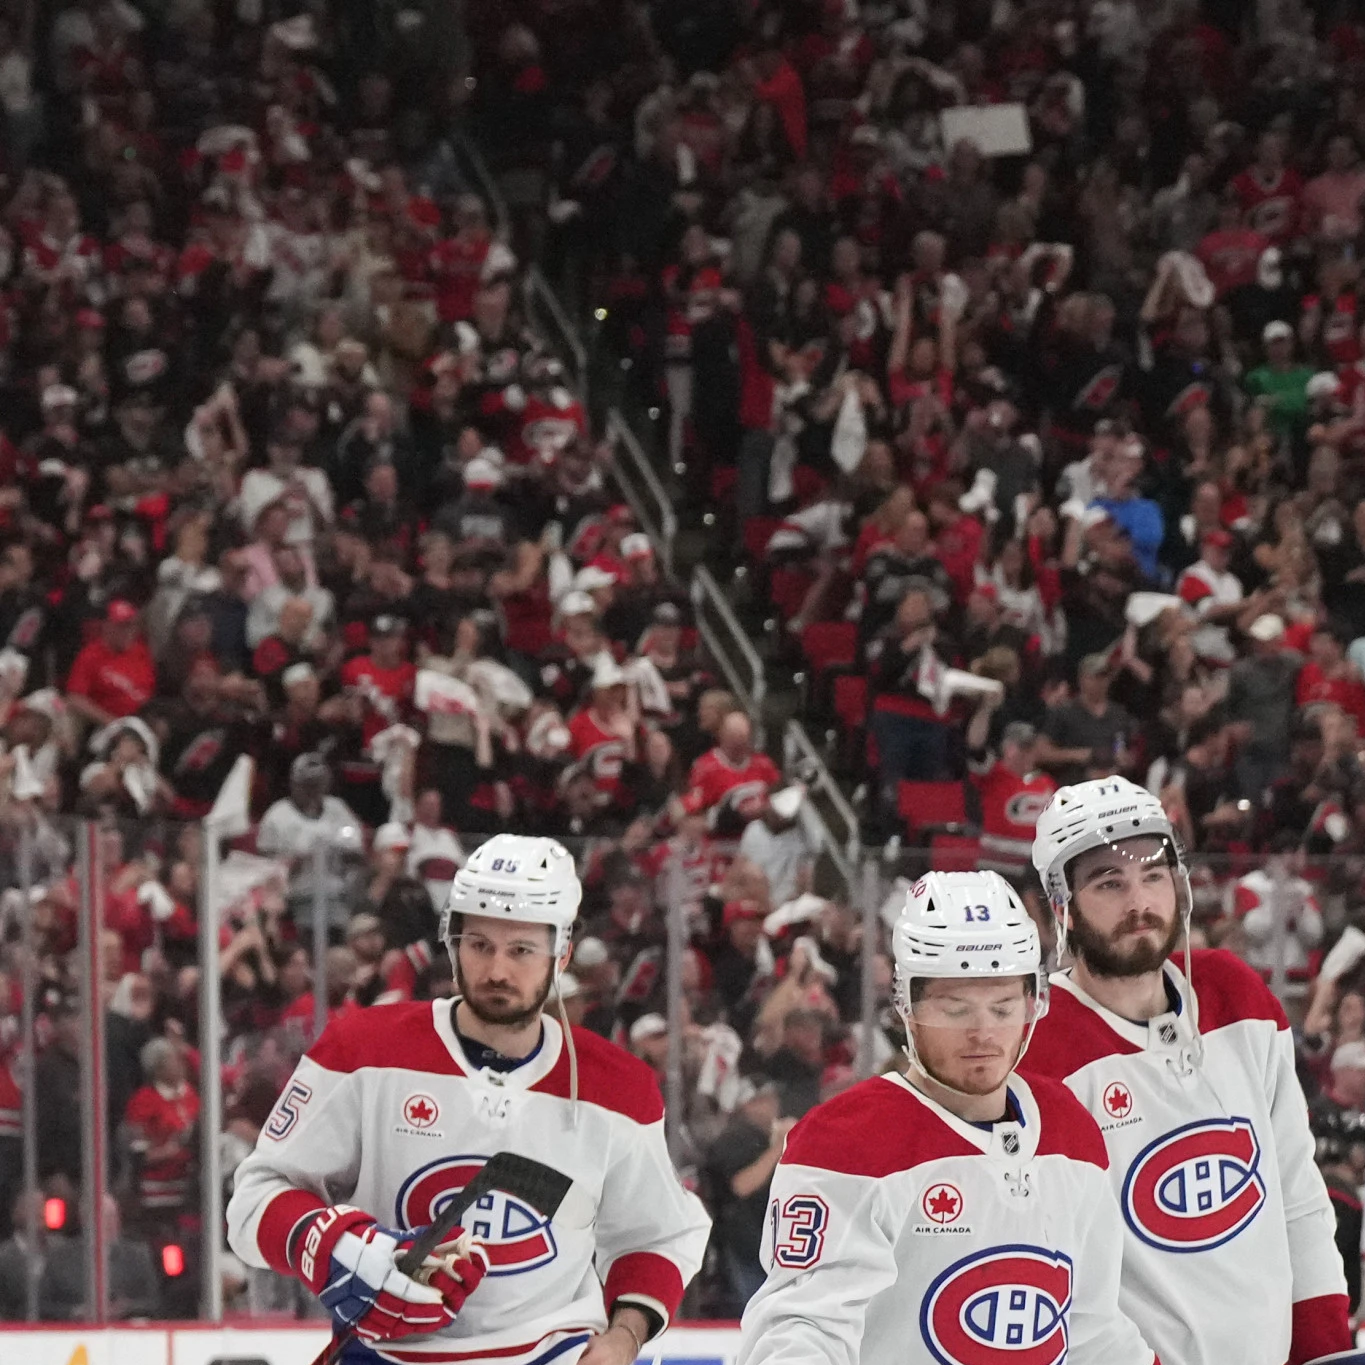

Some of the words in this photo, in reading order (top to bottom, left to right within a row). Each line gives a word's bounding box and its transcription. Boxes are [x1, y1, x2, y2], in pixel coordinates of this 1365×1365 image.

[963, 905, 991, 922] 13
[264, 1079, 313, 1142] 5
[1100, 1124, 1115, 1132] AIR
[1115, 1117, 1143, 1130] CANADA
